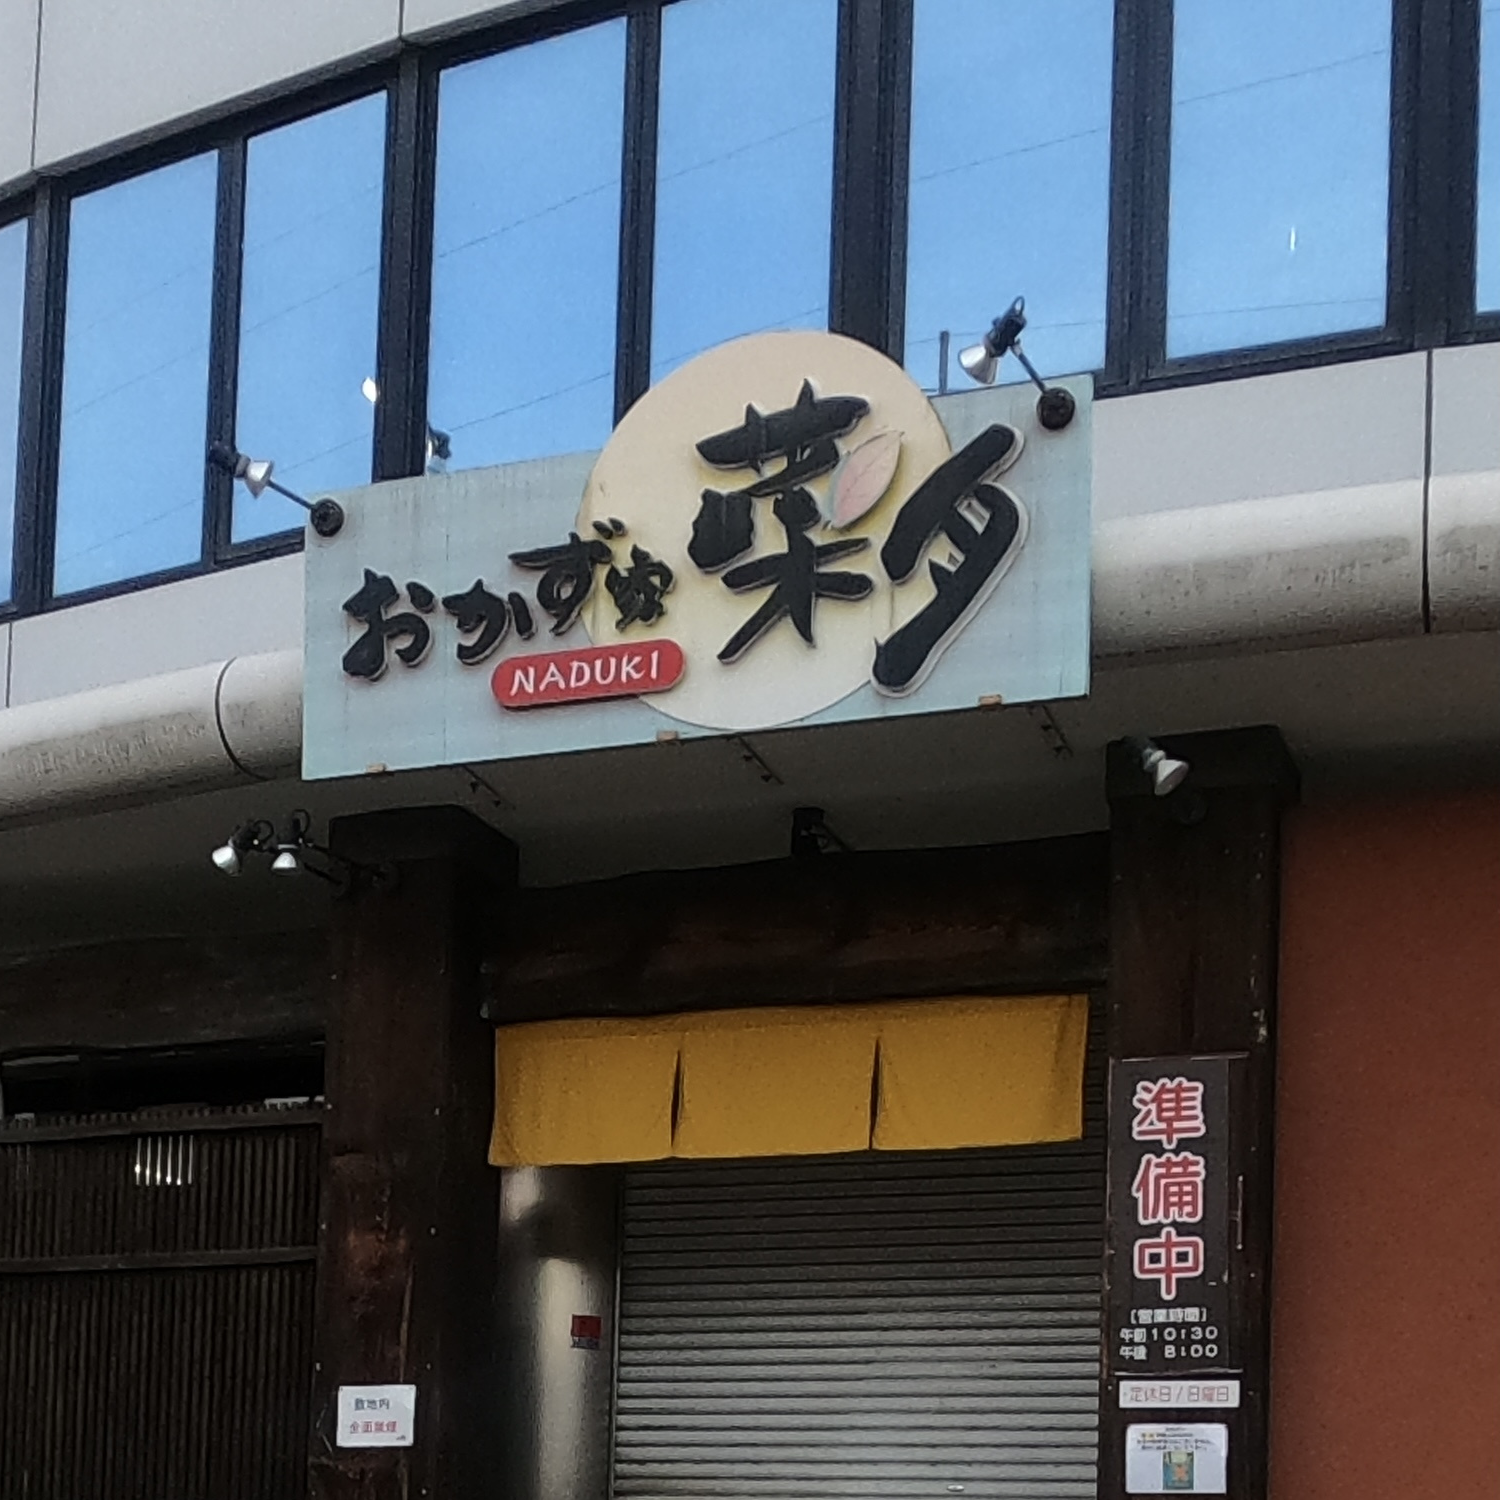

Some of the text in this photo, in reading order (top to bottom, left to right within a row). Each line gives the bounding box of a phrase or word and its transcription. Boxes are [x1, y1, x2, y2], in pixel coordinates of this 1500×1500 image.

[509, 650, 660, 697] NADUKI
[1132, 1077, 1206, 1300] 準備中
